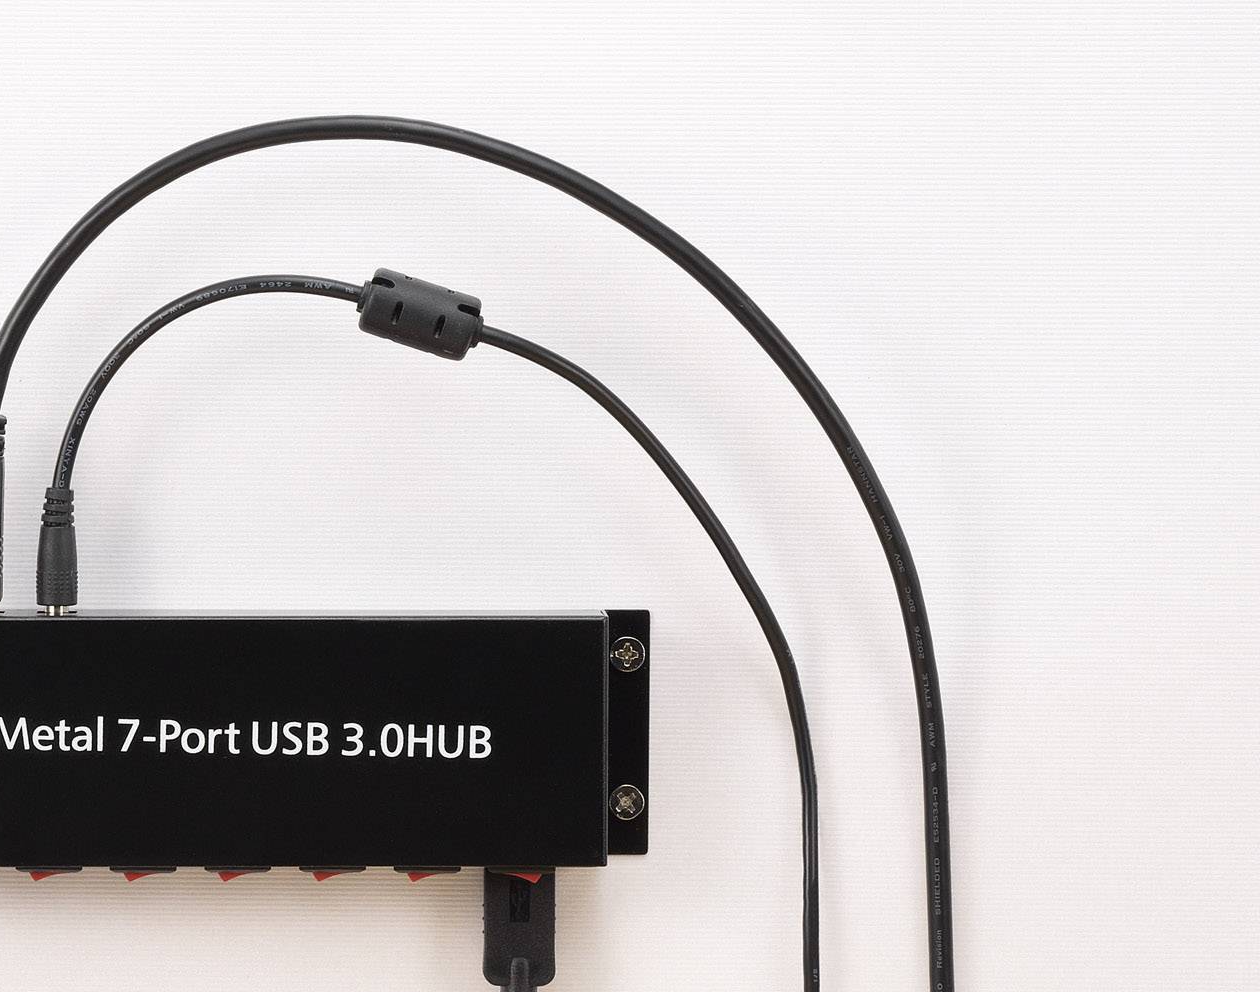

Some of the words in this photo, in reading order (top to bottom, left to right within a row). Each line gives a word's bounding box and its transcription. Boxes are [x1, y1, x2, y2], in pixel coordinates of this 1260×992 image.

[259, 281, 293, 289] 2464
[920, 672, 934, 709] STYLE
[117, 718, 242, 755] 7-Port
[251, 720, 330, 756] USB
[341, 722, 492, 759] 3.0HUB
[934, 856, 943, 916] SHIELDED
[936, 928, 944, 970] Revision
